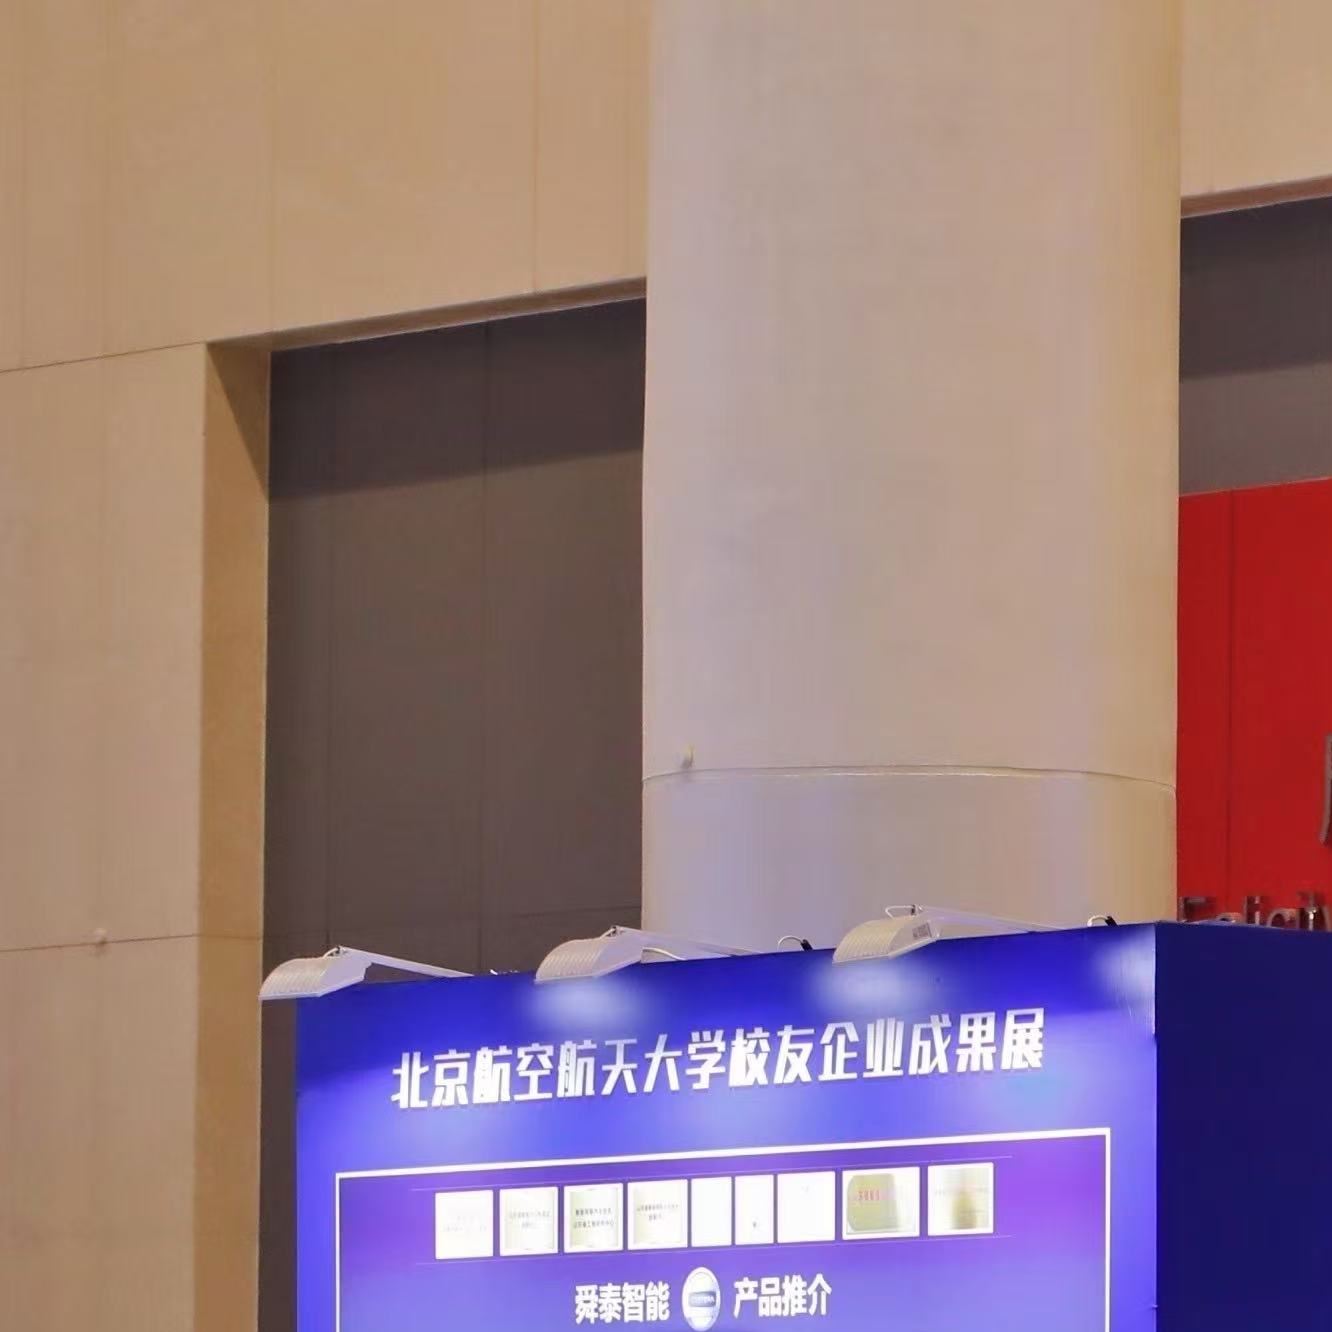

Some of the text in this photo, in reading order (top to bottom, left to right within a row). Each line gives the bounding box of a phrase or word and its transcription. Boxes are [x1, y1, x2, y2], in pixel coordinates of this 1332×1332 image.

[392, 1007, 1047, 1111] 北京航空航天大学校友企业成果展
[575, 1273, 833, 1324] 舜泰智能 产品推介
